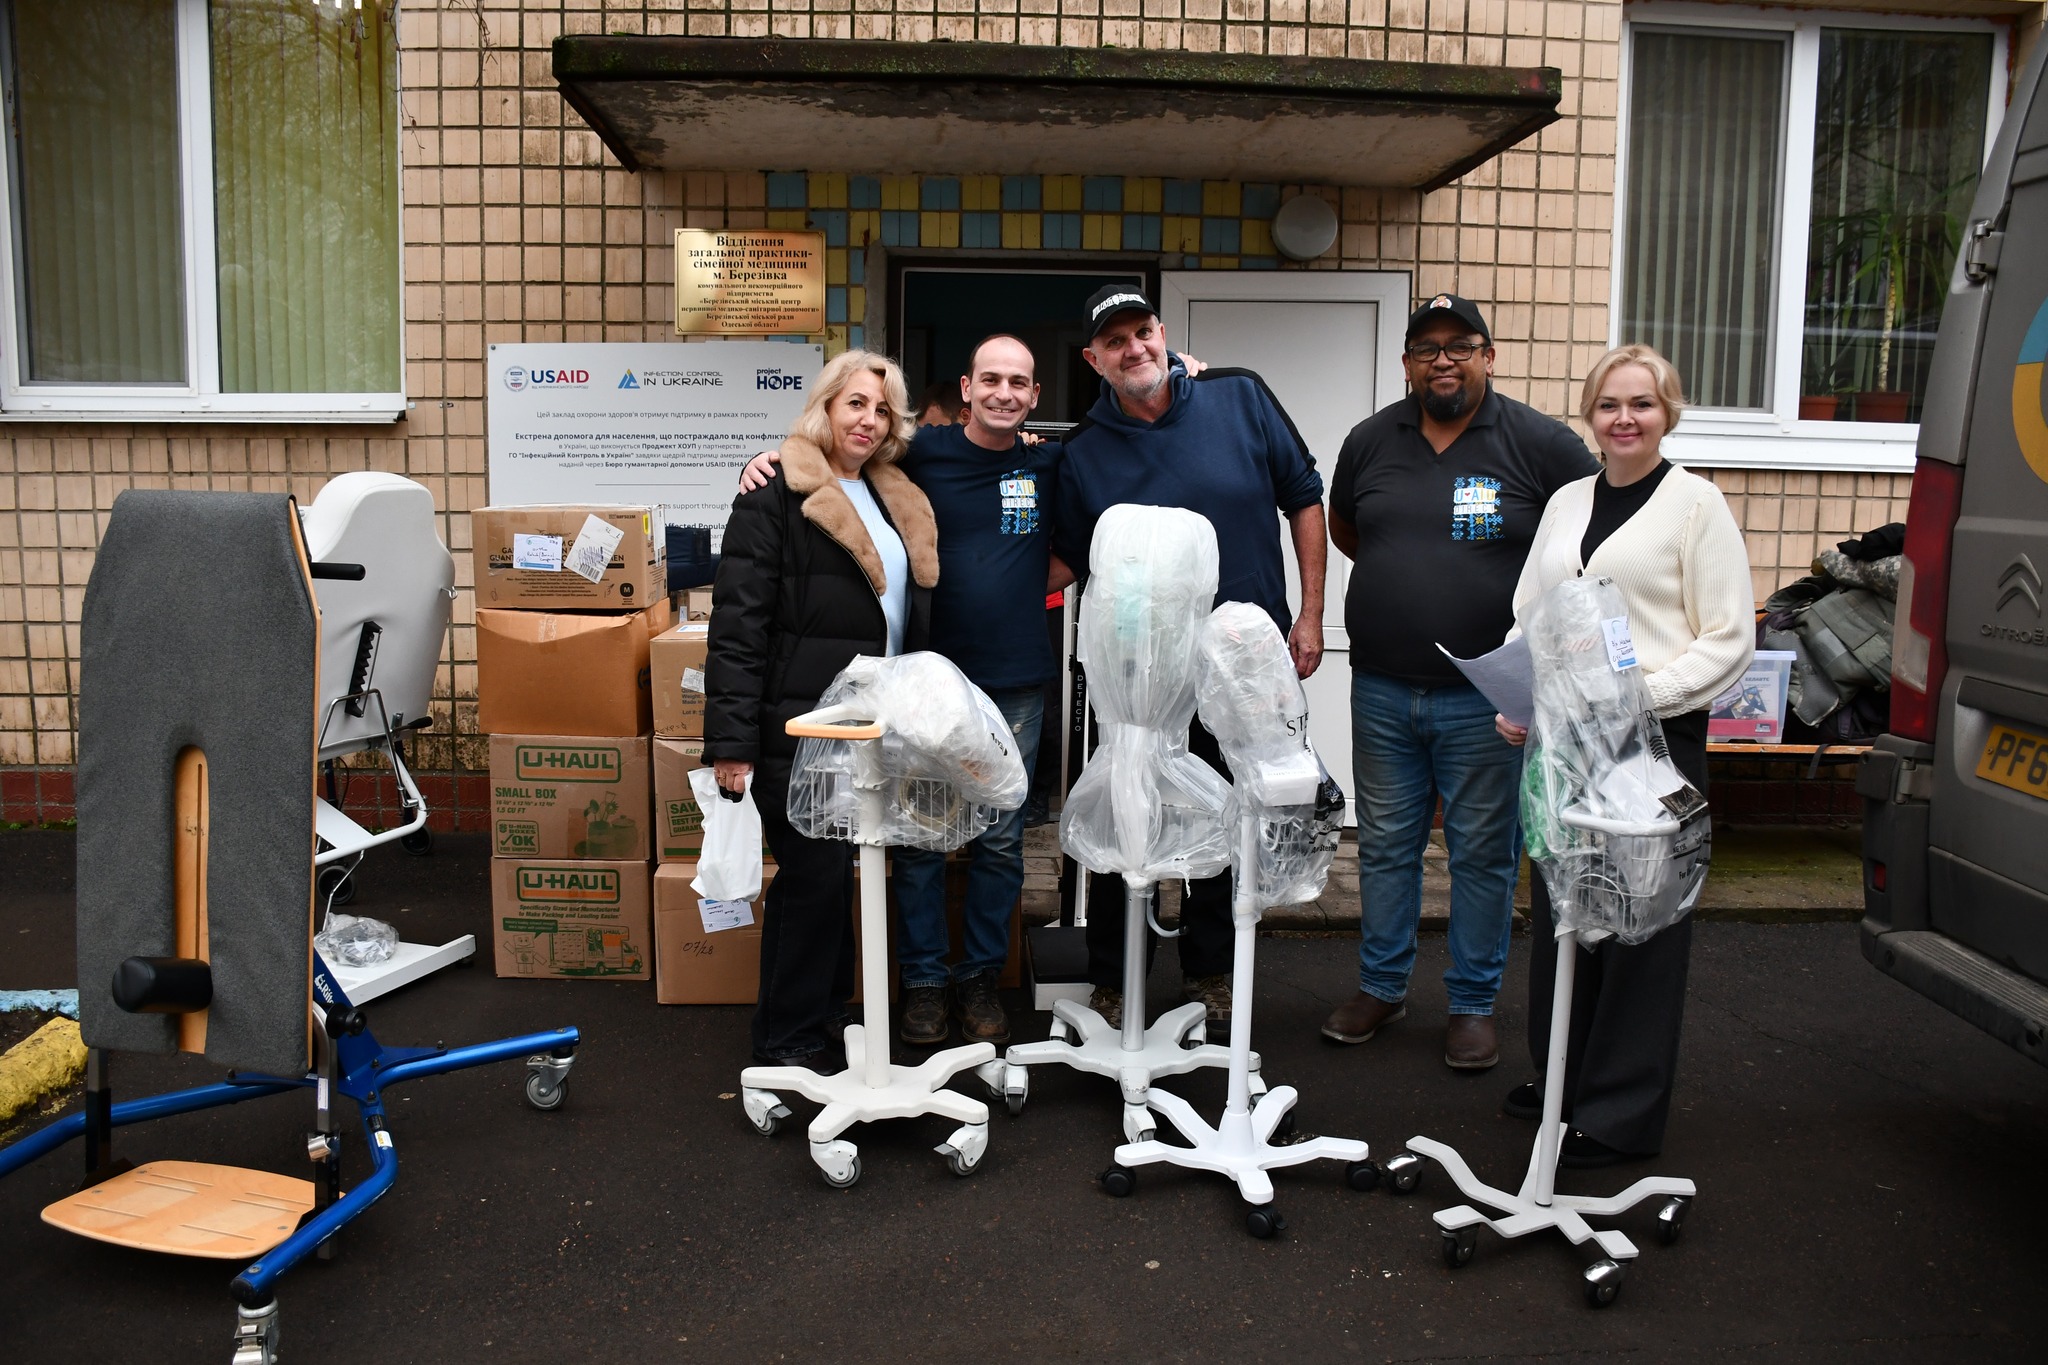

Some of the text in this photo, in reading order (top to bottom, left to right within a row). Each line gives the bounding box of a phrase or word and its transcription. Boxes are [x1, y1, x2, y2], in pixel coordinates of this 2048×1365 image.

[716, 236, 784, 247] Відділення
[688, 247, 813, 260] загальної практики-
[693, 258, 807, 269] сімейної медицини
[713, 269, 787, 282] м. Березівка
[706, 313, 749, 321] Березівської
[721, 321, 752, 329] Одеської
[531, 370, 589, 383] USAID
[756, 368, 781, 376] project
[644, 378, 723, 386] IN UKRAINE
[756, 375, 802, 390] HOPE
[537, 411, 550, 419] Цей
[608, 411, 638, 419] здоров'я
[671, 411, 706, 419] підтримку
[515, 433, 552, 441] Екстрена
[731, 433, 744, 441] від
[702, 502, 729, 511] through
[1075, 674, 1084, 732] DETECTO
[524, 751, 614, 769] U-HAUL
[495, 787, 557, 799] SMALL BOX
[672, 818, 689, 826] BEST
[511, 835, 535, 846] OK
[523, 873, 613, 890] U-HAUL
